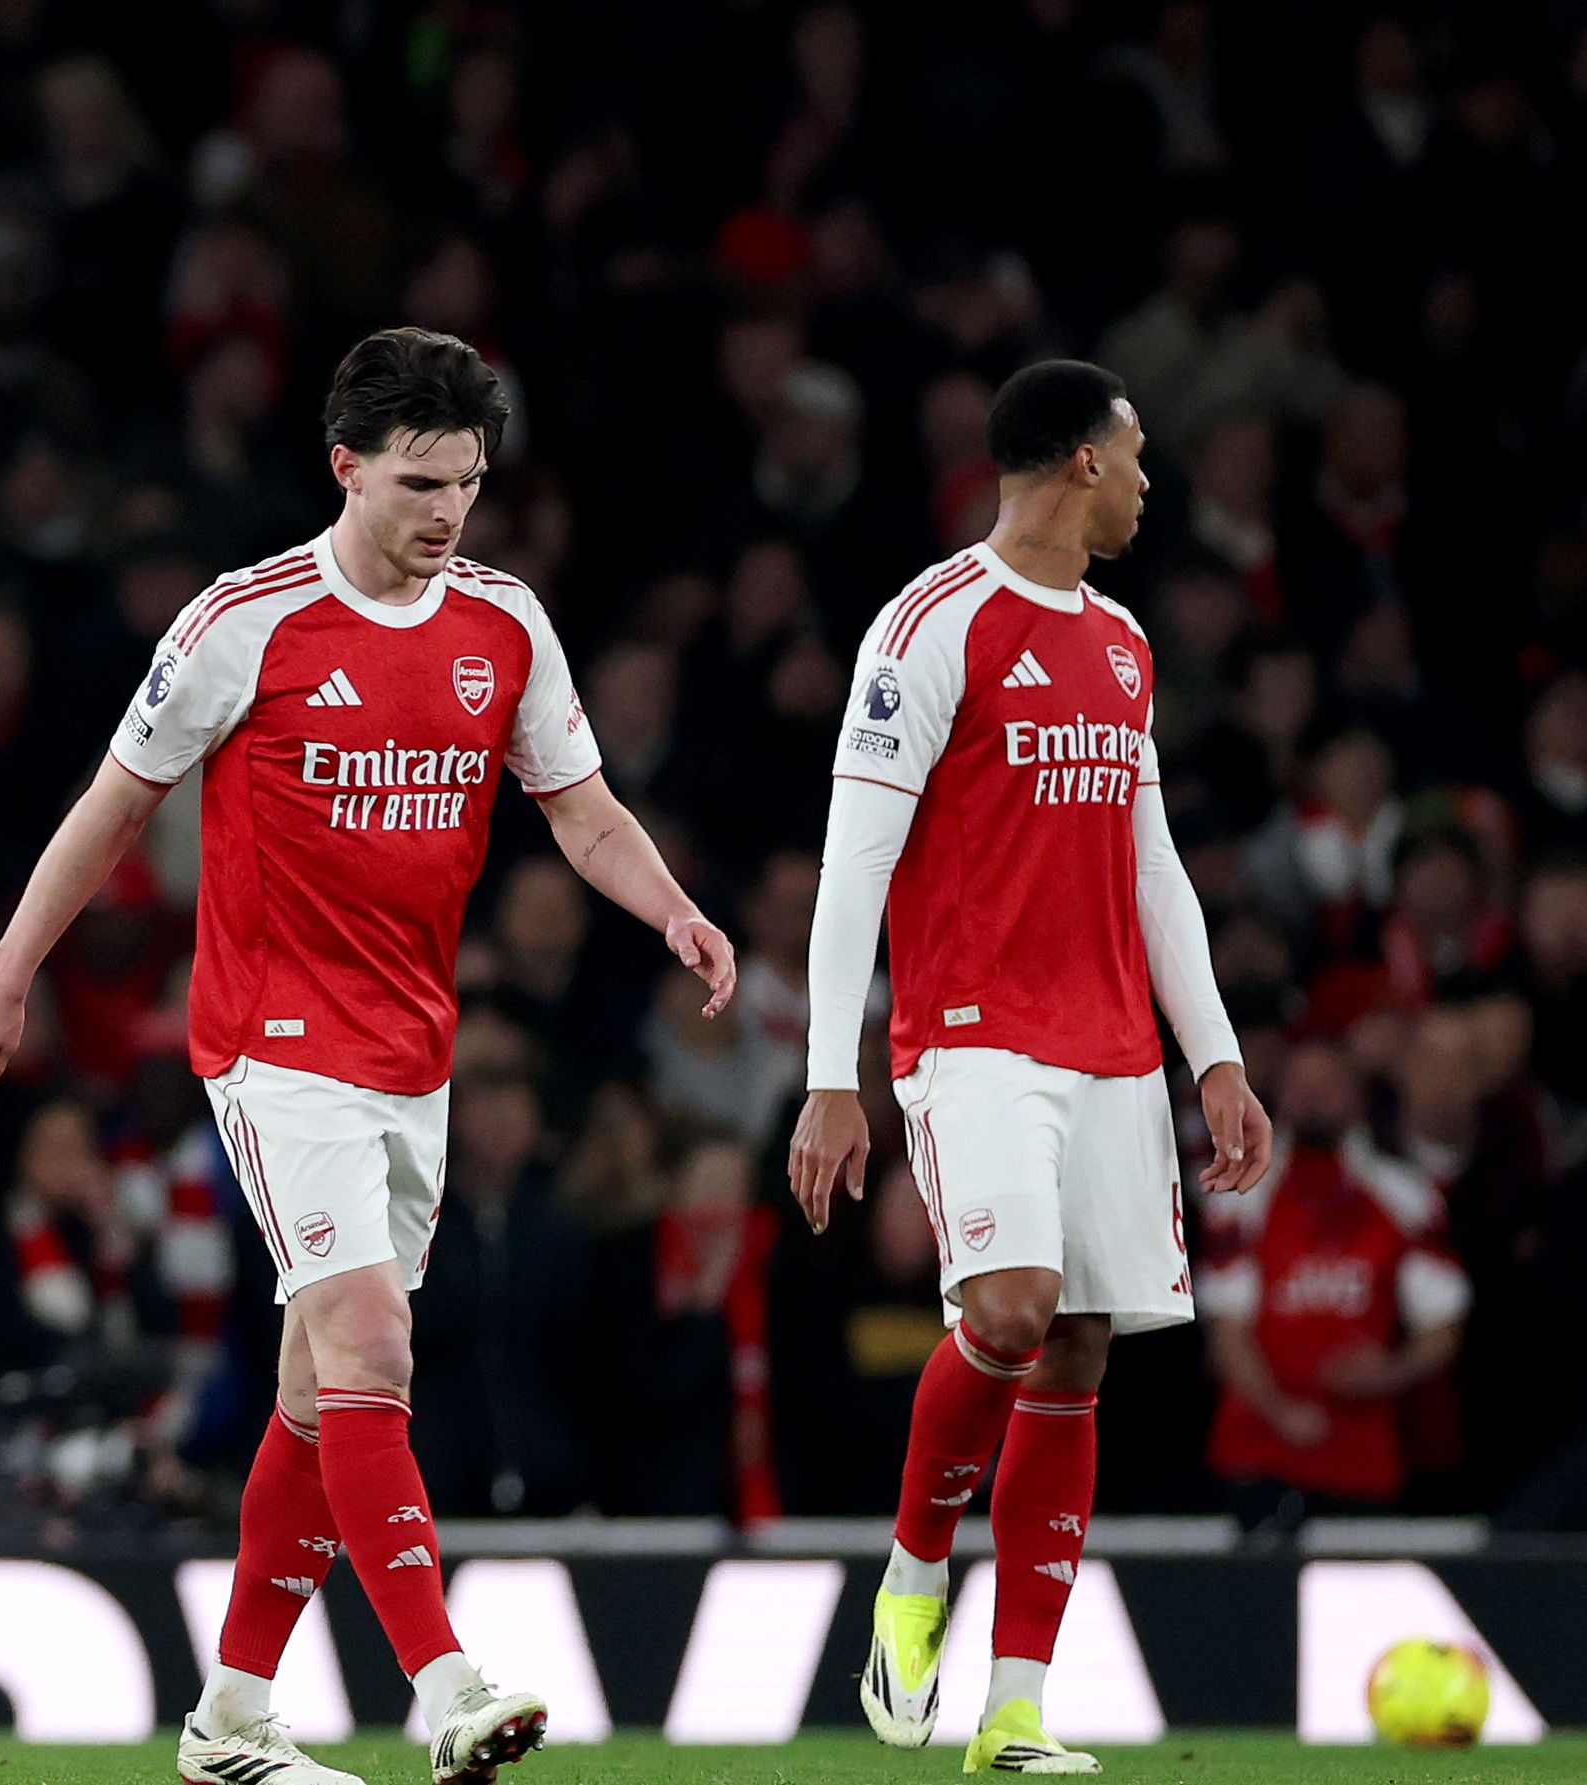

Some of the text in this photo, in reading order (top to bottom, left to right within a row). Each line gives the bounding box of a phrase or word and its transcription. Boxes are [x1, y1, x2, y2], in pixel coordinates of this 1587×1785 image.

[460, 666, 489, 677] Arsenal
[863, 732, 895, 749] room
[1004, 712, 1145, 768] Emirates
[303, 739, 490, 787] Emirates
[1034, 767, 1076, 806] FLY
[330, 792, 466, 831] FLY BETTER
[300, 1217, 328, 1234] Arsenal
